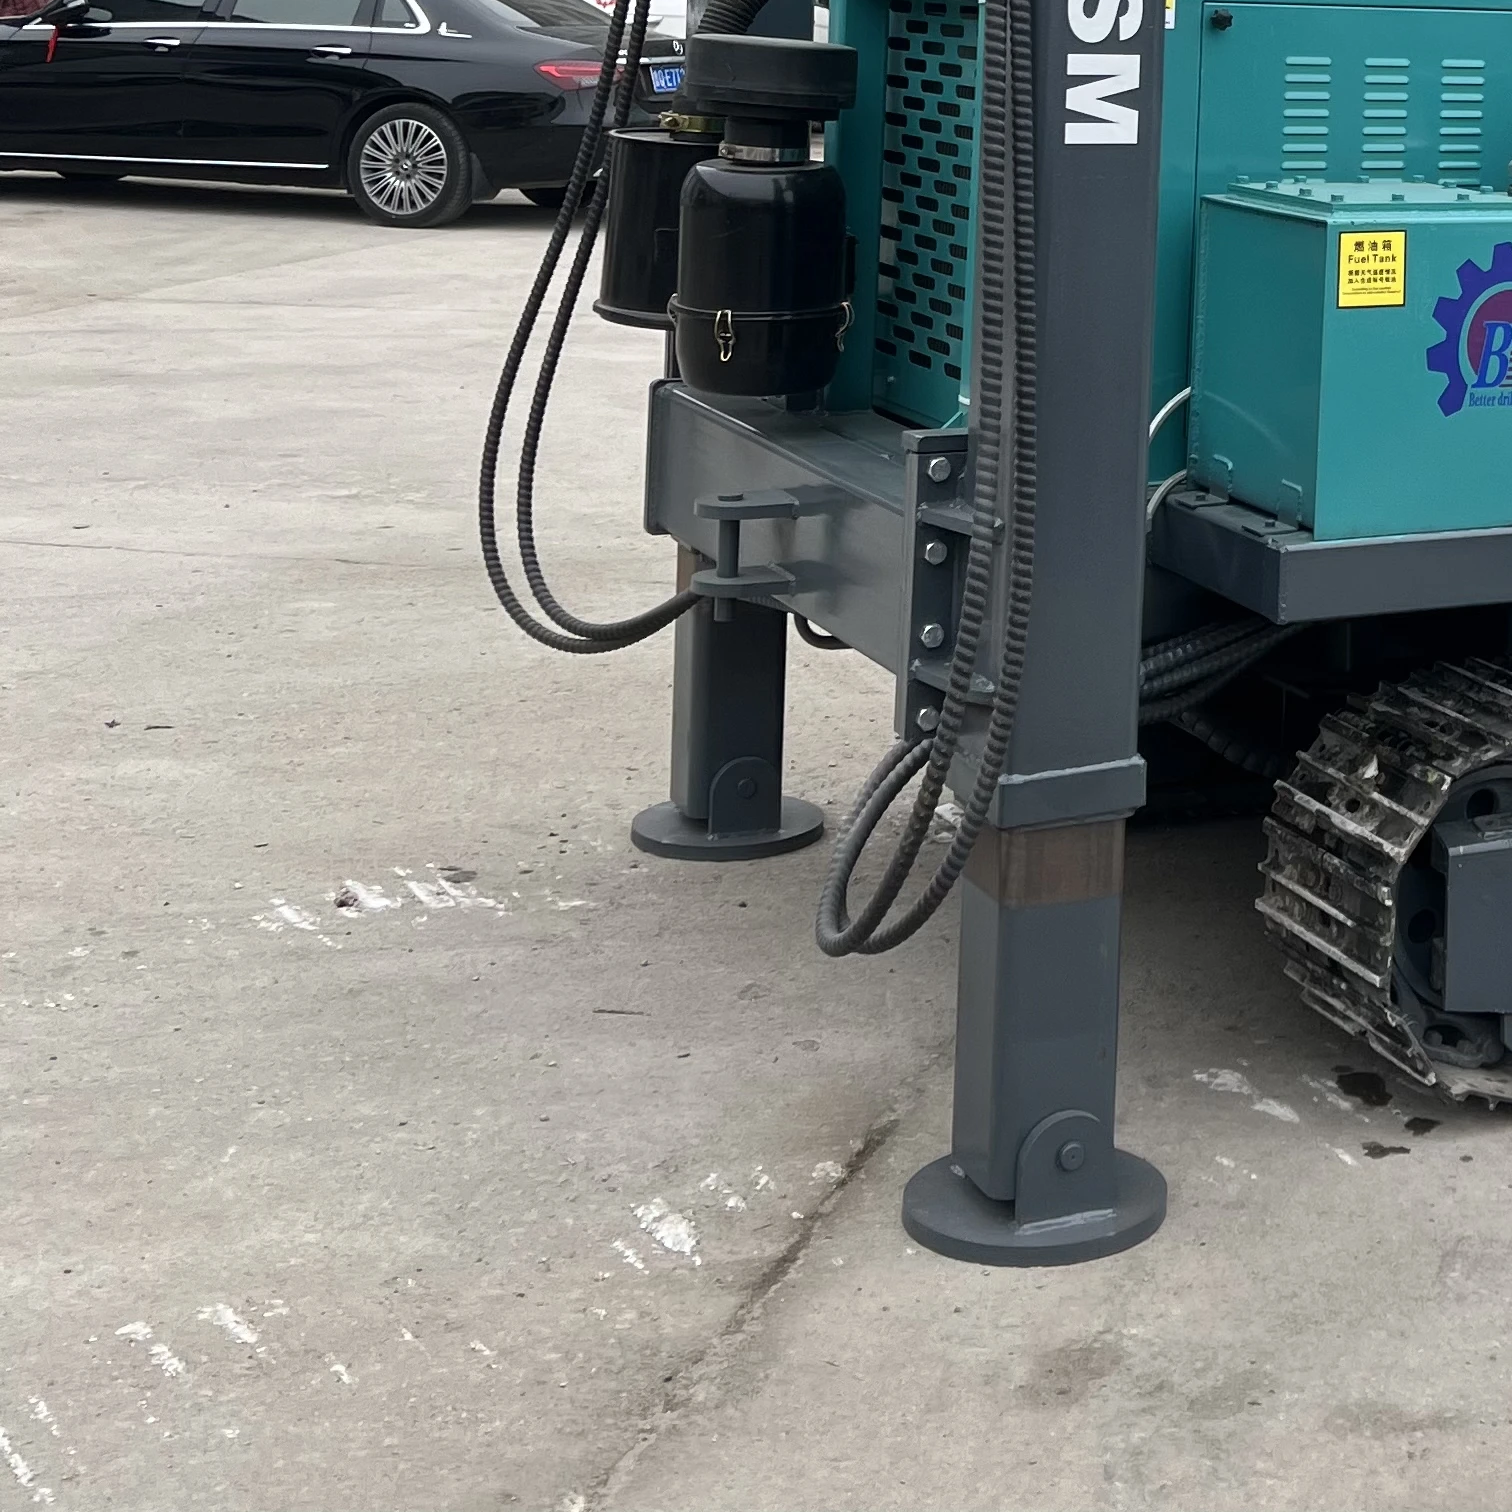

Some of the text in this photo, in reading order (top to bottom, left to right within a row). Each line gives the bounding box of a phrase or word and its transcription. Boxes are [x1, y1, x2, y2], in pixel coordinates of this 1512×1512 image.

[1348, 253, 1397, 264] Fuel Tank
[1468, 391, 1496, 407] Better
